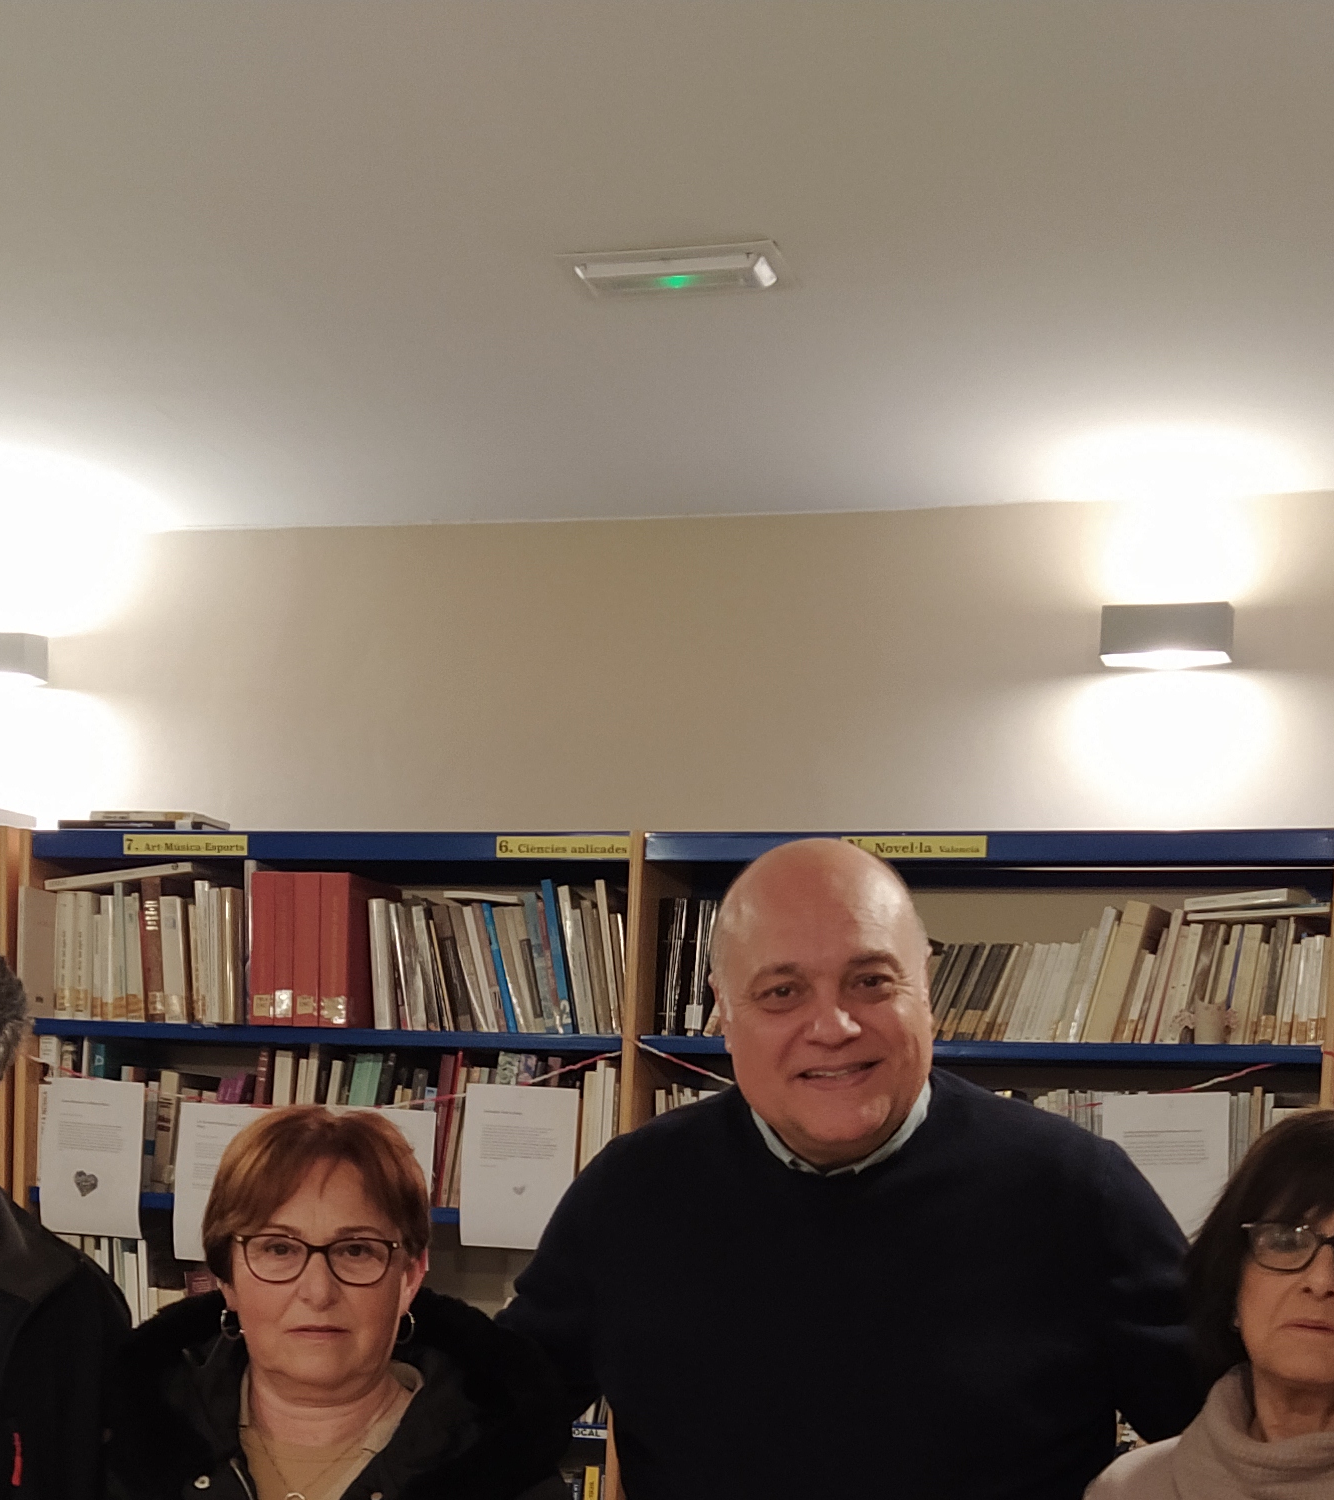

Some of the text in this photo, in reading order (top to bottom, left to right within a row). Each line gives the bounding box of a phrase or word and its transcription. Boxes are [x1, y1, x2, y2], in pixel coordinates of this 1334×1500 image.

[125, 838, 139, 851] 7.
[498, 840, 513, 853] 6.
[517, 843, 567, 854] Ciències
[875, 842, 932, 854] Novel·la
[572, 1428, 600, 1438] OCAL
